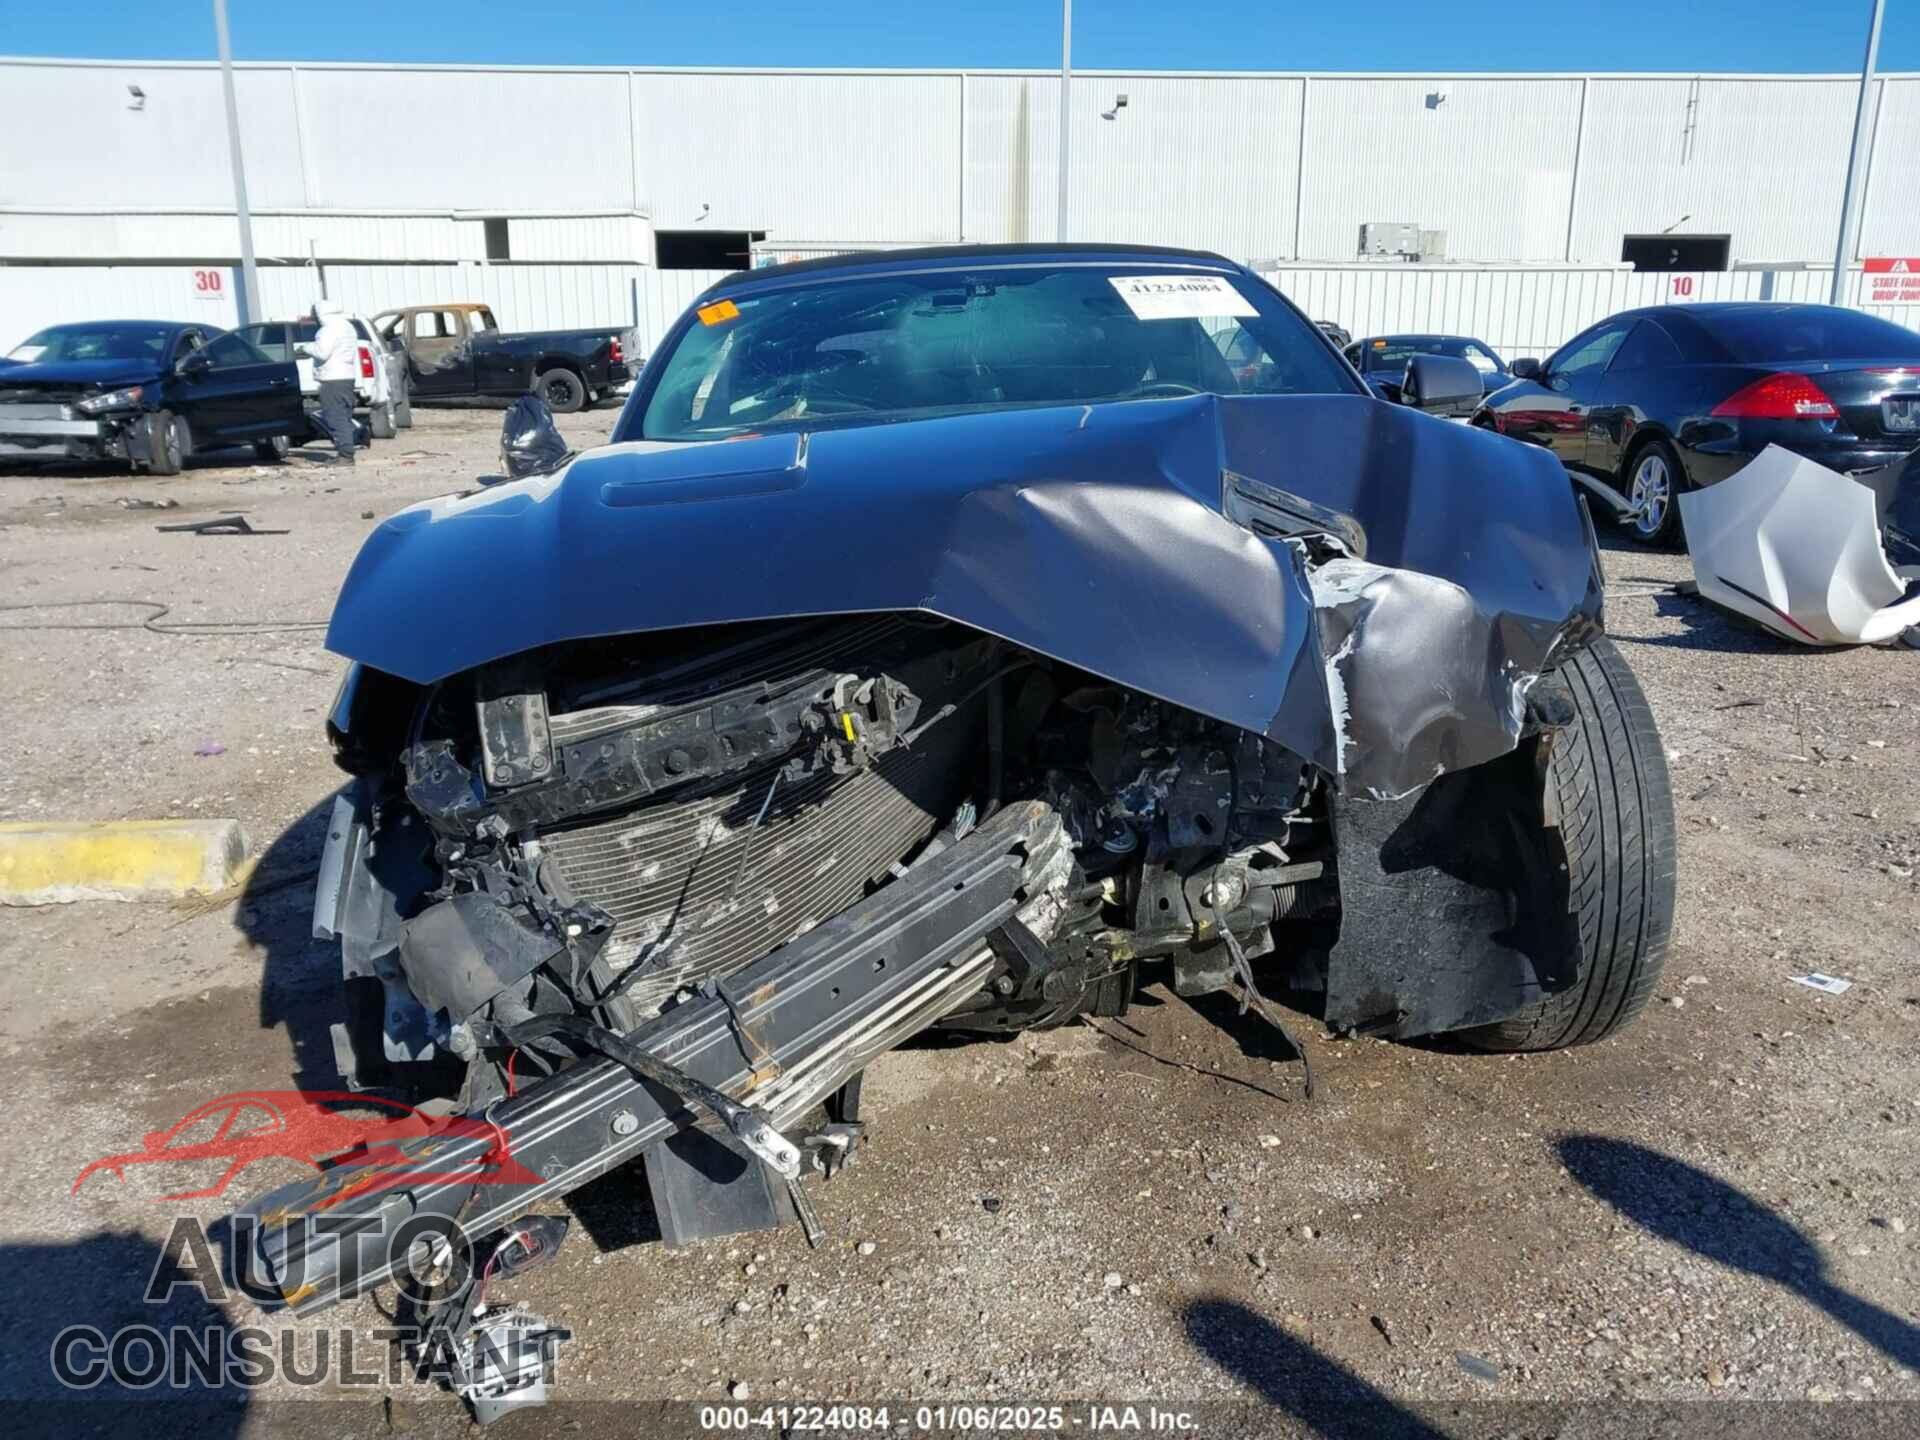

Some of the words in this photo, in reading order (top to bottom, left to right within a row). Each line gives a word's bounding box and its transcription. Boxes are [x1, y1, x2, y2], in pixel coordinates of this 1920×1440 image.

[194, 270, 221, 291] 30
[1672, 276, 1693, 296] 10
[1872, 277, 1899, 288] STATE
[1130, 283, 1222, 294] 41224084
